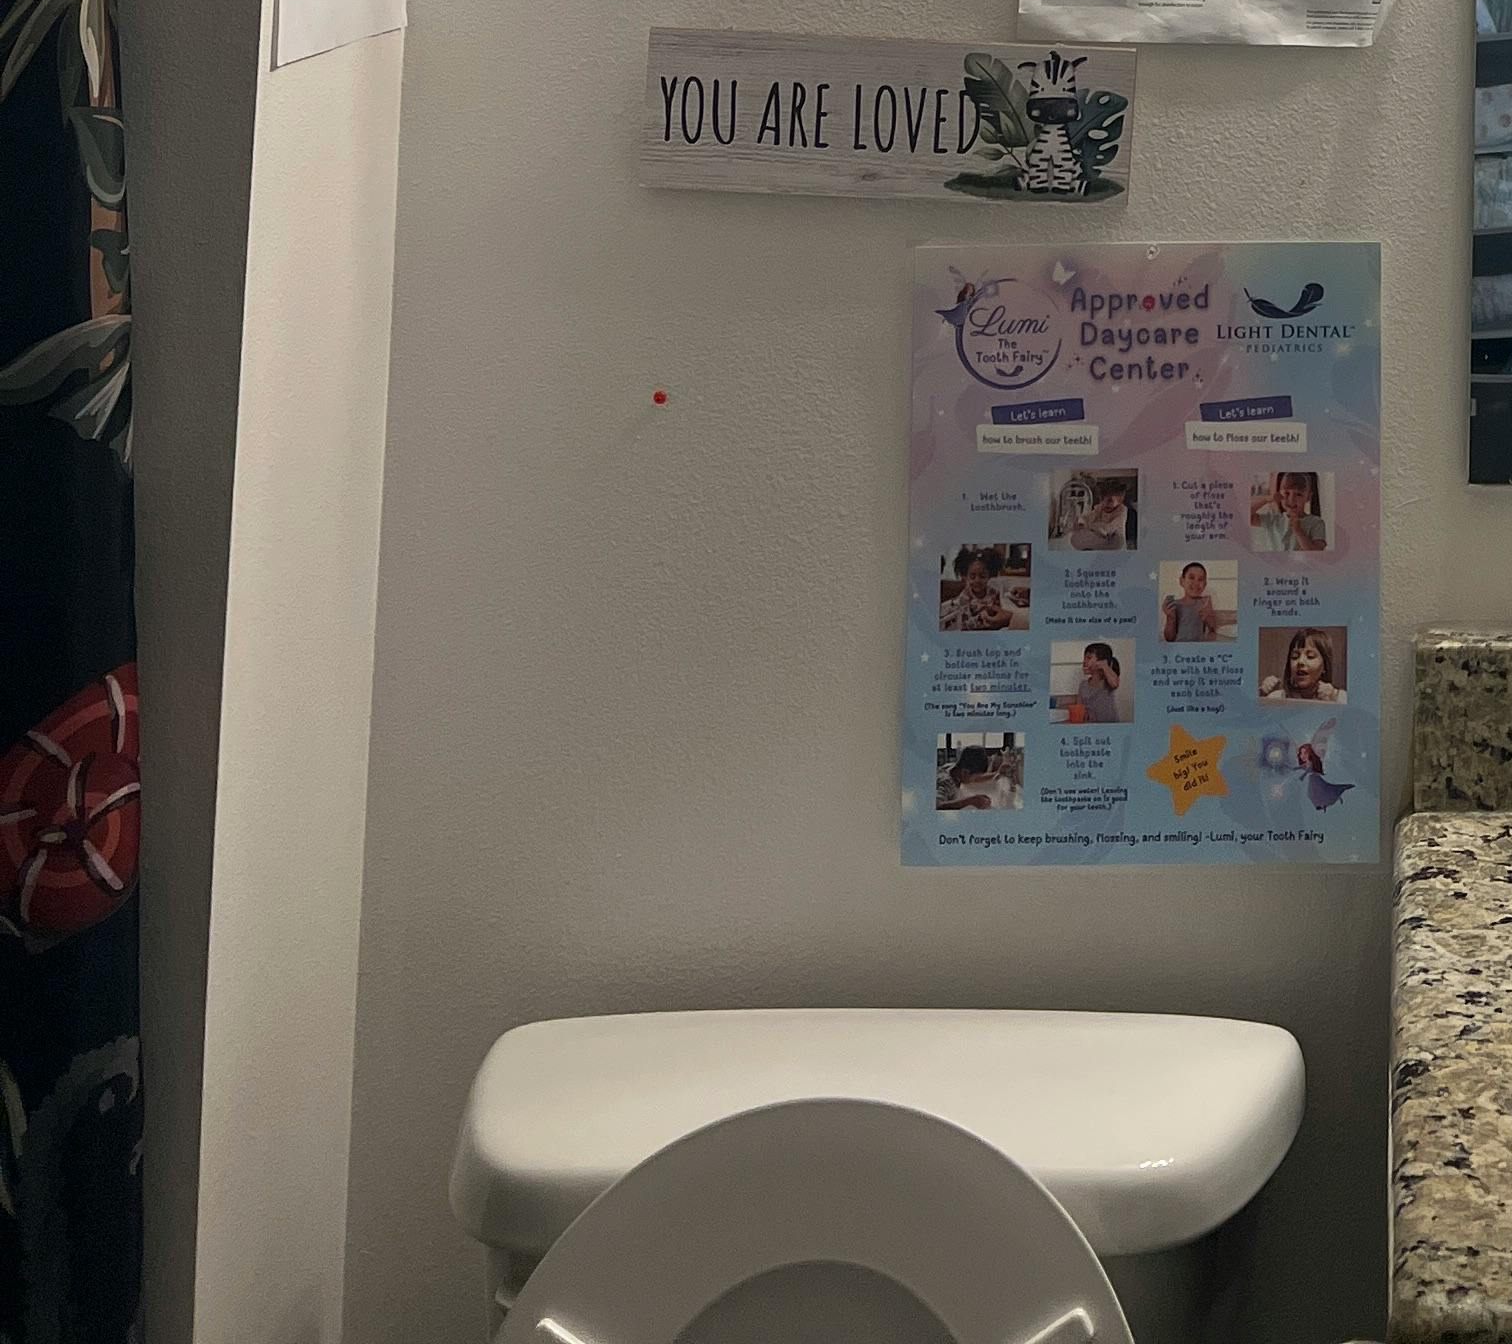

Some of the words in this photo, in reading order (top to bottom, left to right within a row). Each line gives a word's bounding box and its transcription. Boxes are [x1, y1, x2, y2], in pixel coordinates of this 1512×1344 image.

[660, 75, 738, 145] YOU
[756, 81, 831, 149] ARE
[853, 84, 981, 155] LOVED
[968, 305, 1051, 336] Lumi
[1080, 321, 1199, 353] Daycare
[1217, 324, 1274, 340] LIGHT
[997, 338, 1017, 349] The
[1246, 343, 1323, 353] PEDIATRICS
[975, 351, 1009, 363] Tooth
[1089, 355, 1190, 380] Center
[1010, 409, 1035, 422] Let's
[1038, 407, 1066, 419] learn
[1219, 406, 1245, 420] Let's
[1246, 404, 1275, 416] learn
[982, 434, 1000, 444] how
[1003, 434, 1013, 444] to
[1015, 434, 1042, 444] brush
[1192, 432, 1212, 442] how
[1213, 432, 1223, 443] to
[939, 833, 966, 846] Don't
[968, 833, 1002, 848] forget
[1004, 833, 1016, 845] to
[1017, 833, 1043, 847] keep
[1045, 832, 1094, 847] brushing,
[1141, 833, 1161, 843] and
[1240, 833, 1264, 845] your
[1267, 830, 1296, 842] Tooth
[1298, 829, 1325, 845] Fairy
